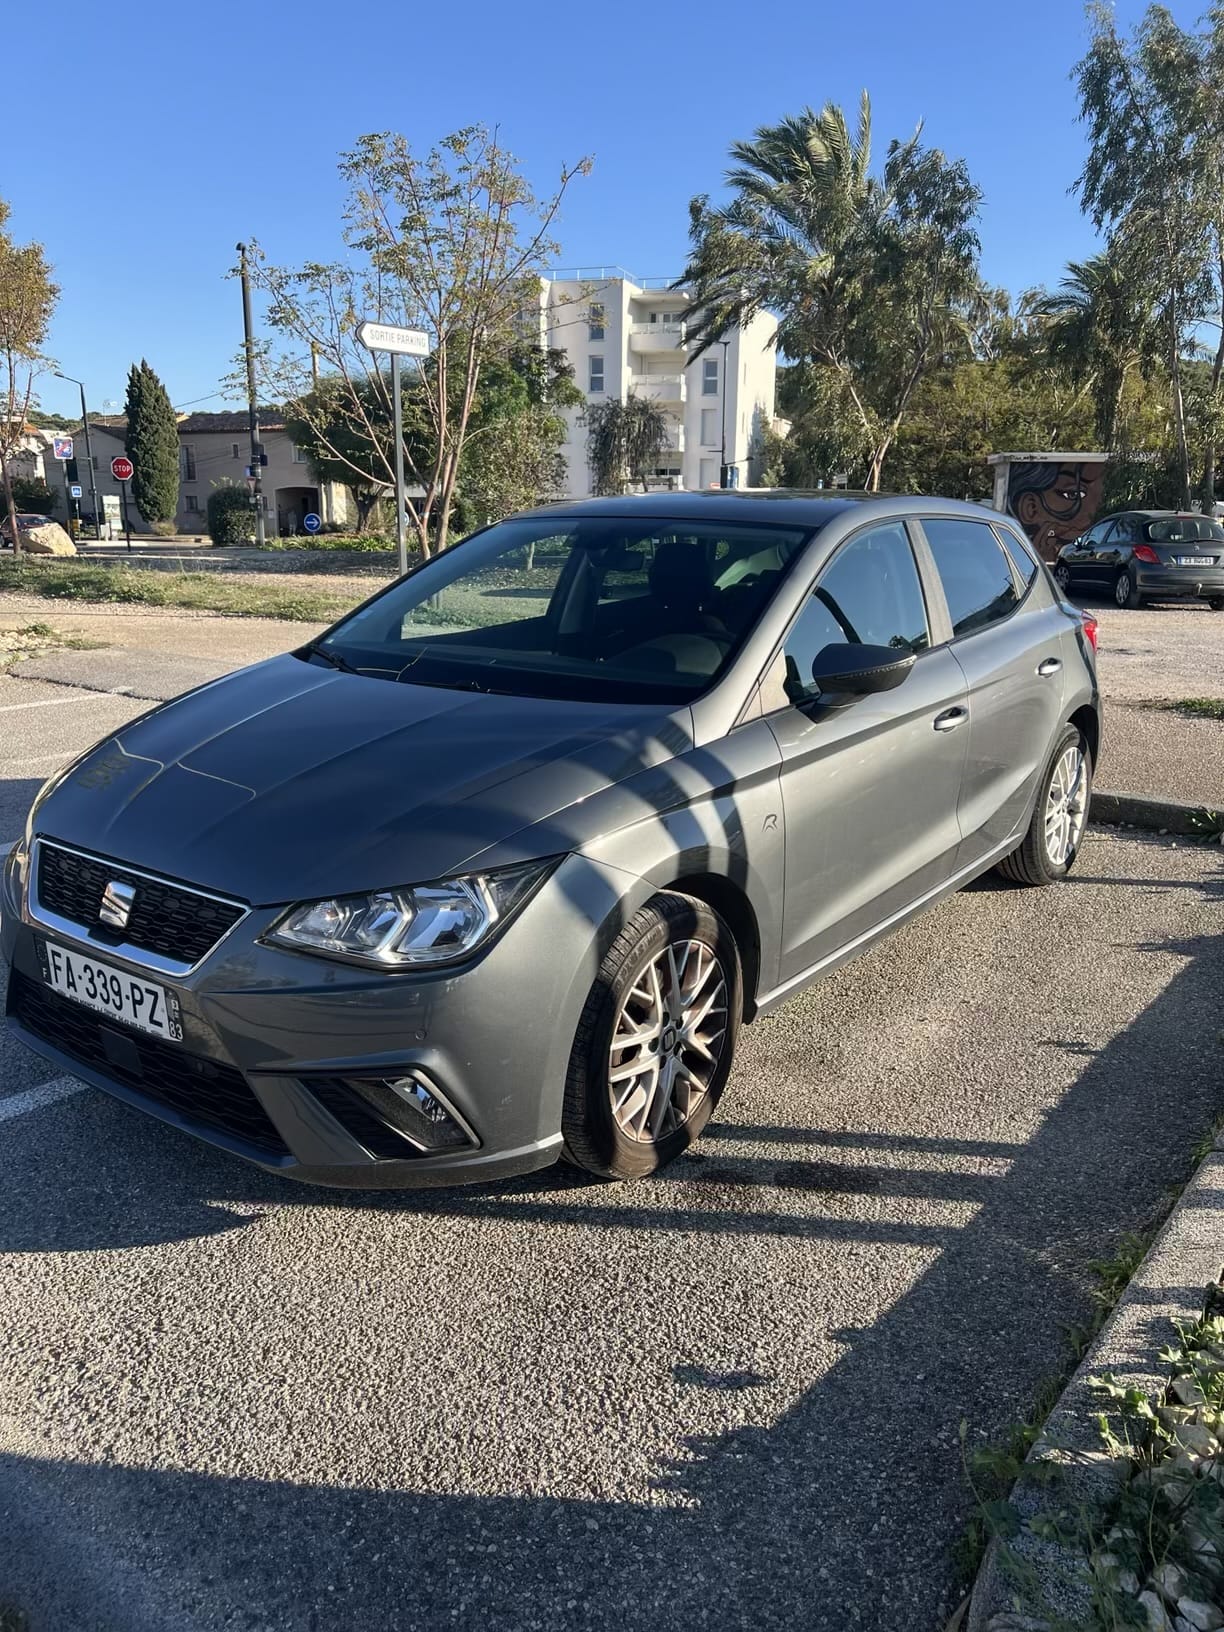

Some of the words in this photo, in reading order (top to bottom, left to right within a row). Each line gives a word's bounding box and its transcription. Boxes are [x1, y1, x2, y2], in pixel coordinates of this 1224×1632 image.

[370, 329, 396, 343] SORTIE
[397, 333, 426, 348] PARKING
[169, 1020, 183, 1040] 83
